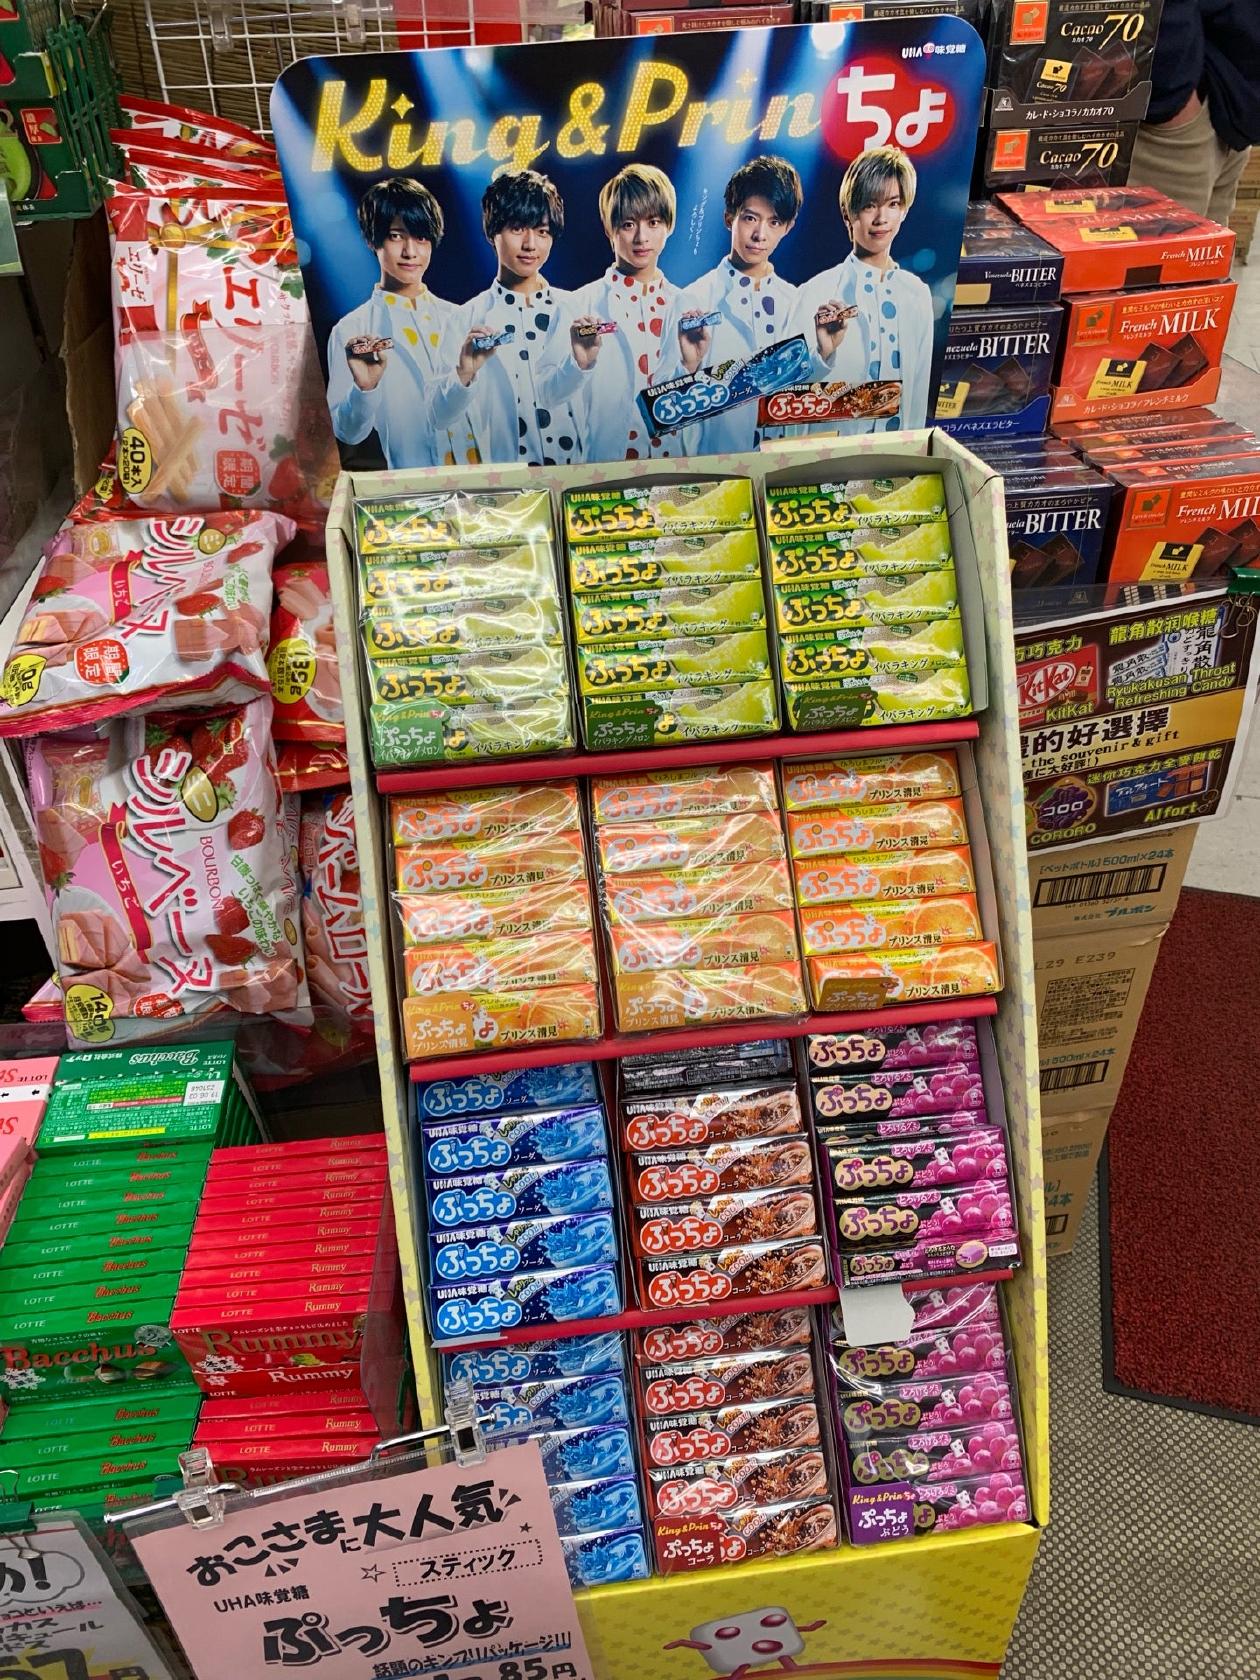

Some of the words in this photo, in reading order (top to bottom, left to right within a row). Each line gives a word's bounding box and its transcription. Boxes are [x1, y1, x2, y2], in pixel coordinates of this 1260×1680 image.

[1060, 21, 1103, 37] Cacao
[1099, 13, 1144, 50] 70
[311, 79, 549, 182] King
[556, 82, 610, 159] &
[616, 61, 821, 153] Prin
[837, 65, 947, 151] ちょ
[1039, 150, 1081, 165] Cacao
[1075, 142, 1119, 176] 70
[1161, 251, 1186, 261] French
[1186, 245, 1226, 262] MILK
[128, 247, 146, 302] エリーゼ
[1010, 267, 1057, 283] BITTER
[1119, 318, 1157, 334] French
[1158, 308, 1221, 336] MILK
[217, 266, 267, 452] エリーゼ
[977, 333, 1050, 358] BITTER
[1111, 380, 1132, 389] MILK
[655, 385, 728, 422] ぷっちょ
[130, 436, 146, 489] 40本入
[1023, 508, 1102, 535] BITTER
[1176, 504, 1217, 518] French
[579, 557, 661, 584] ぷっちょ
[779, 548, 857, 575] ぷっちょ
[588, 658, 669, 685] ぷっちょ
[791, 646, 869, 674] ぷっちょ
[379, 671, 466, 700] ぷっちょ
[1106, 674, 1187, 698] Ryukakusan
[1192, 662, 1236, 679] Throat
[1114, 687, 1187, 709] Refreshing
[1192, 676, 1235, 693] Candy
[1045, 703, 1094, 723] KitKat
[594, 722, 649, 736] ぷっちょ
[1031, 756, 1055, 767] the
[1060, 742, 1129, 761] souvenir
[1132, 738, 1142, 748] &
[1146, 730, 1180, 747] gift
[870, 787, 923, 800] プリンス清見
[1042, 800, 1084, 818] コロロ
[1143, 802, 1198, 823] Alfort
[799, 824, 871, 850] ぷっちょ
[876, 836, 929, 849] プリンス清見
[1030, 822, 1096, 846] CORORO
[110, 859, 140, 909] いちご
[128, 748, 215, 998] シルベーヌ
[199, 835, 224, 911] BOURBON
[490, 870, 546, 885] プリンス清見
[811, 921, 883, 948] ぷっちょ
[889, 932, 942, 947] プリンス清見
[704, 950, 760, 965] プリンス清見
[1075, 951, 1116, 964] E239
[905, 982, 961, 998] プリンス清見
[65, 1054, 93, 1063] ロッテ
[128, 1049, 200, 1067] Bacchus
[812, 1037, 882, 1066] ぷっちょ
[428, 1081, 502, 1114] ぷっちょ
[632, 1115, 705, 1146] ぷっちょ
[838, 1159, 910, 1187] ぷっちょ
[319, 1207, 353, 1217] Rummy
[437, 1191, 515, 1225] ぷっちょ
[646, 1219, 719, 1250] ぷっちょ
[442, 1243, 519, 1278] ぷっちょ
[852, 1257, 895, 1274] ぷっちょ
[309, 1282, 344, 1293] Rummy
[200, 1328, 360, 1354] Rummy
[1, 1341, 158, 1370] Bacchus
[844, 1349, 911, 1375] ぷっちょ
[268, 1368, 353, 1383] Rummy
[653, 1381, 723, 1410] ぷっちょ
[325, 1417, 362, 1431] Rummy
[321, 1440, 358, 1454] Rummy
[186, 1479, 504, 1588] おこさまに大人気
[880, 1525, 910, 1537] ぶどう
[663, 1539, 714, 1559] ぷっちょ
[688, 1555, 715, 1567] コーラ
[213, 1583, 311, 1613] UHA味覚糖
[263, 1592, 515, 1666] ぷっちょ
